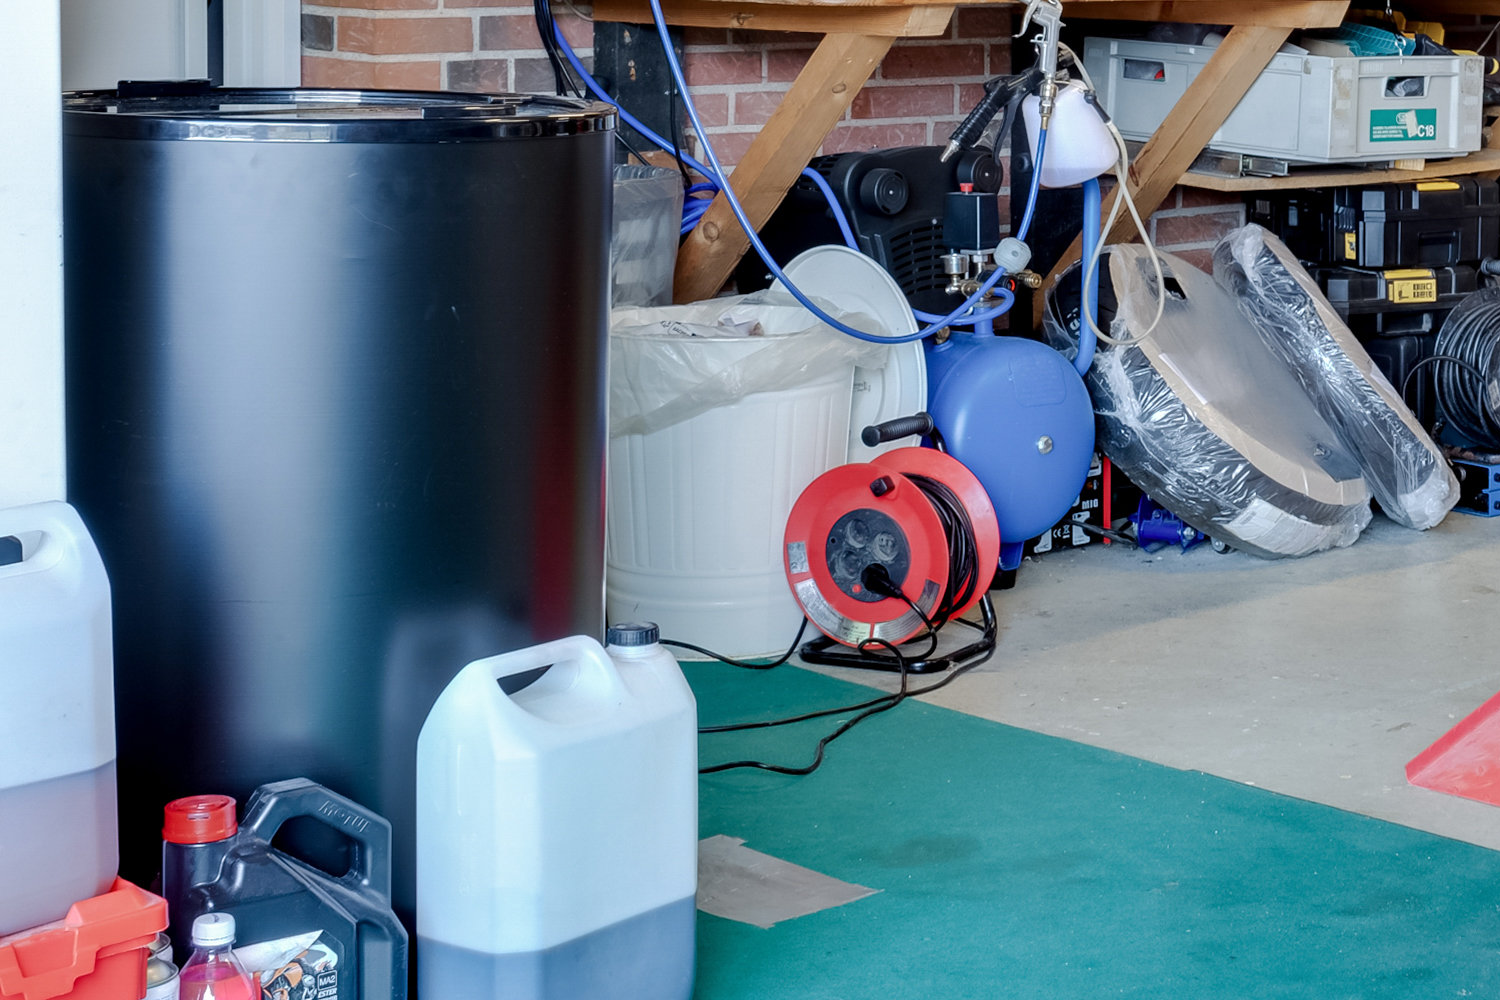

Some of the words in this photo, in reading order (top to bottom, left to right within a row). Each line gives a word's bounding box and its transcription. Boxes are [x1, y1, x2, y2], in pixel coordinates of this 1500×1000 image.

[1417, 124, 1435, 137] C18
[1082, 498, 1099, 510] MIG
[318, 799, 370, 833] MOTUL
[319, 974, 336, 986] MA2
